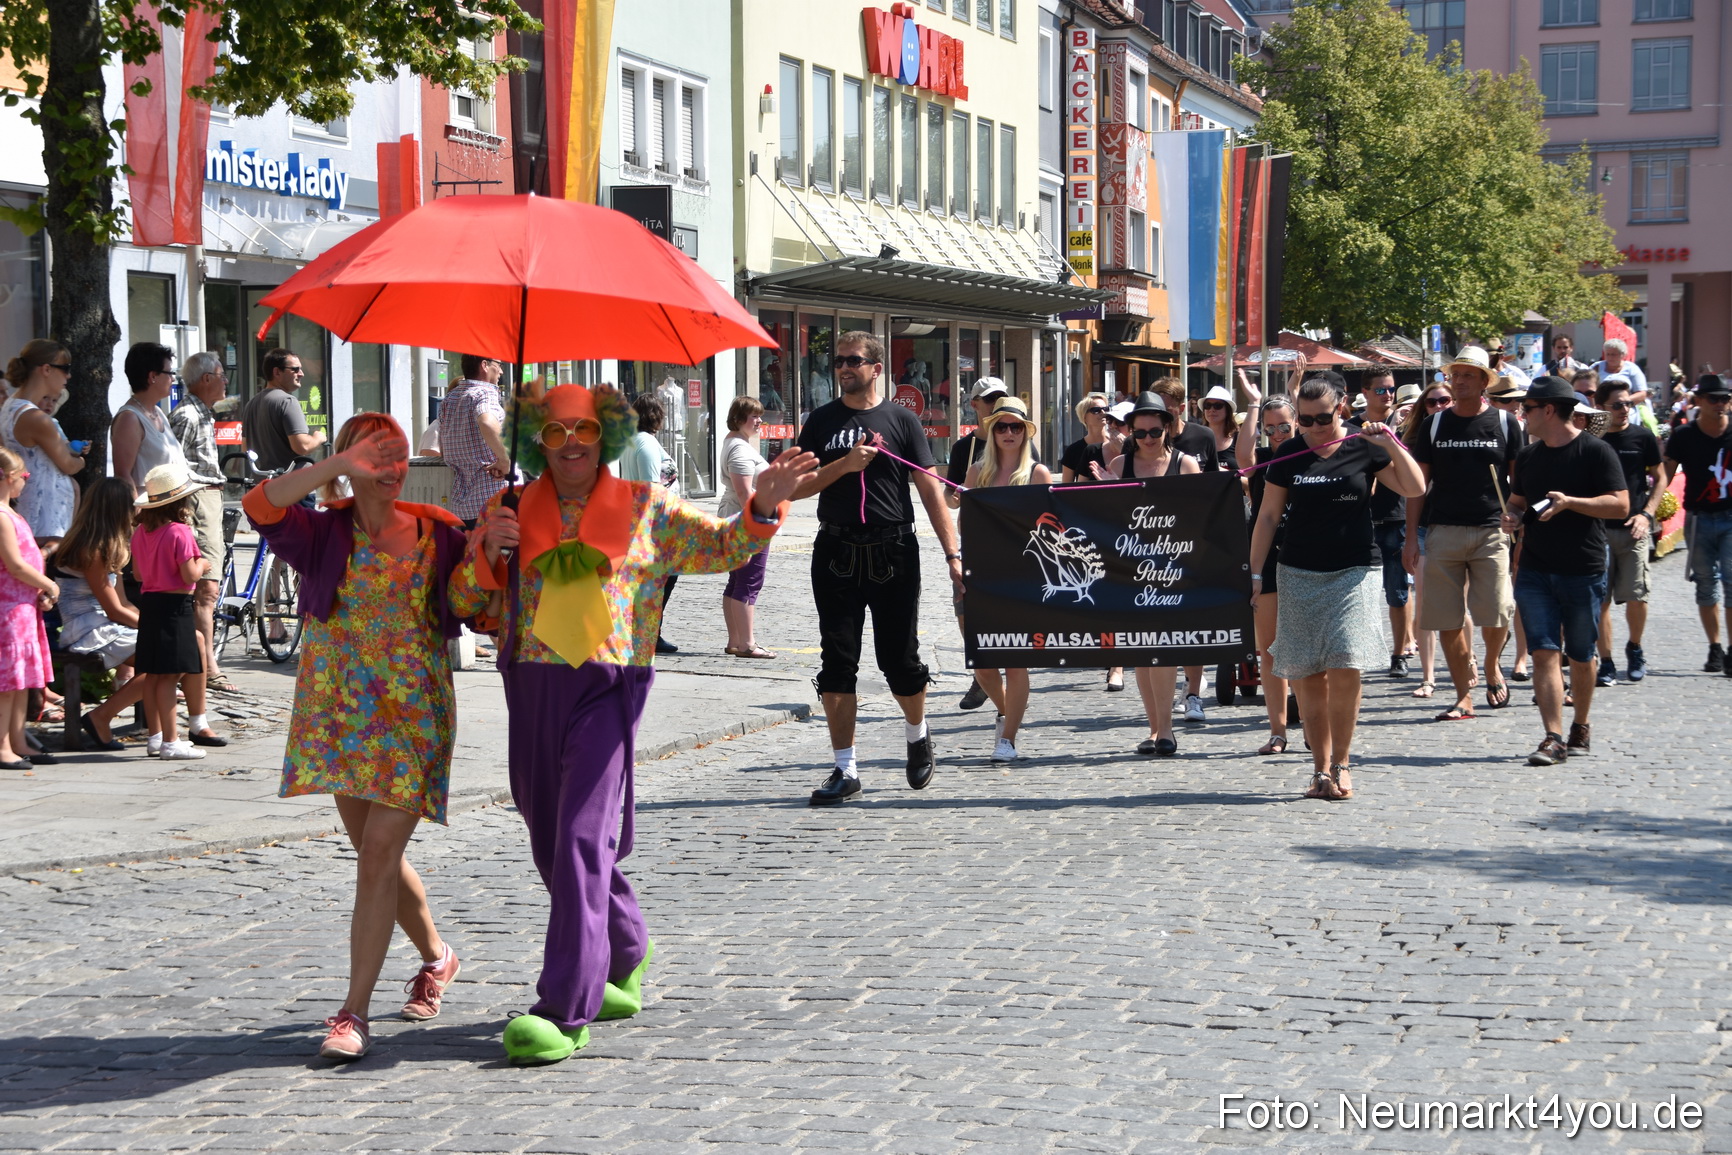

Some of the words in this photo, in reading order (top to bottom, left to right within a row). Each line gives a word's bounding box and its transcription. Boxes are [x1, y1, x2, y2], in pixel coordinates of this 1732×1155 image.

[863, 2, 968, 101] WÖHRL
[1072, 31, 1090, 224] BÄCKEREI
[205, 140, 290, 191] mister
[298, 152, 350, 210] lady
[1069, 233, 1092, 246] café
[893, 397, 917, 407] 25%
[1435, 438, 1499, 448] talentfrei
[1292, 474, 1342, 485] Dance...
[1128, 504, 1176, 530] Kurse
[1114, 533, 1193, 561] Worskhops
[1133, 558, 1183, 588] Partys
[1134, 584, 1183, 607] Shows
[976, 628, 1242, 649] WWW.SALSA-NEUMARKT.DE
